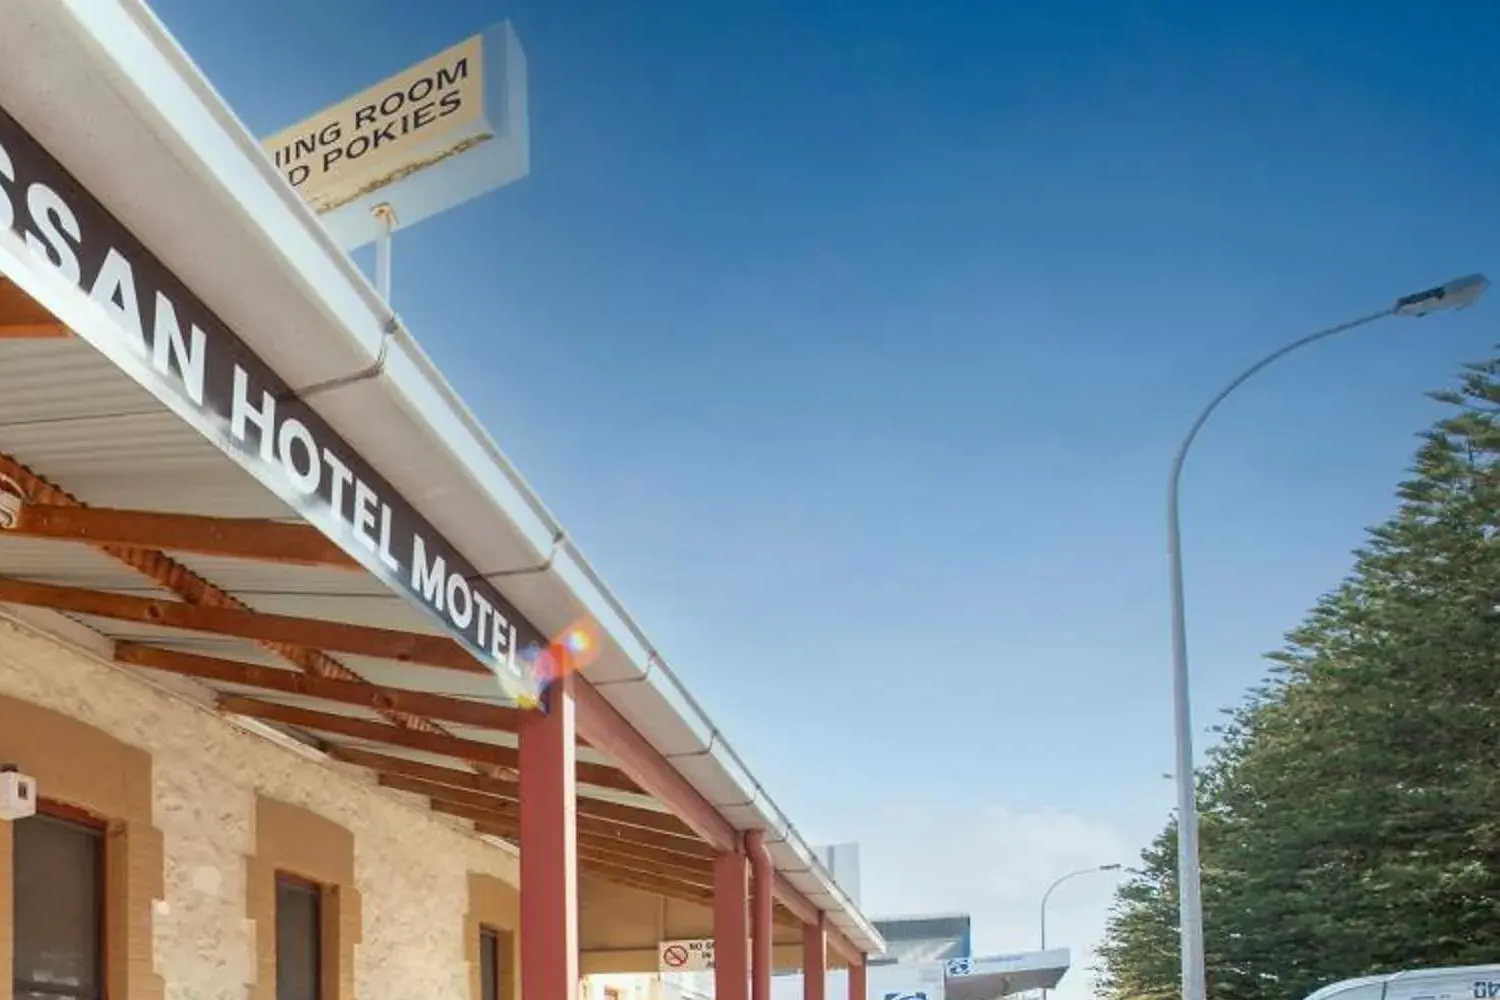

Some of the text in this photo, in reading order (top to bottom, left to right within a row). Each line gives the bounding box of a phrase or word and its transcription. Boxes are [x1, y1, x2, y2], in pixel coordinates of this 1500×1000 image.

[274, 57, 468, 168] ING ROOM
[323, 90, 462, 173] POKIES
[231, 364, 399, 573] HOTEL
[412, 534, 522, 677] MOTEL
